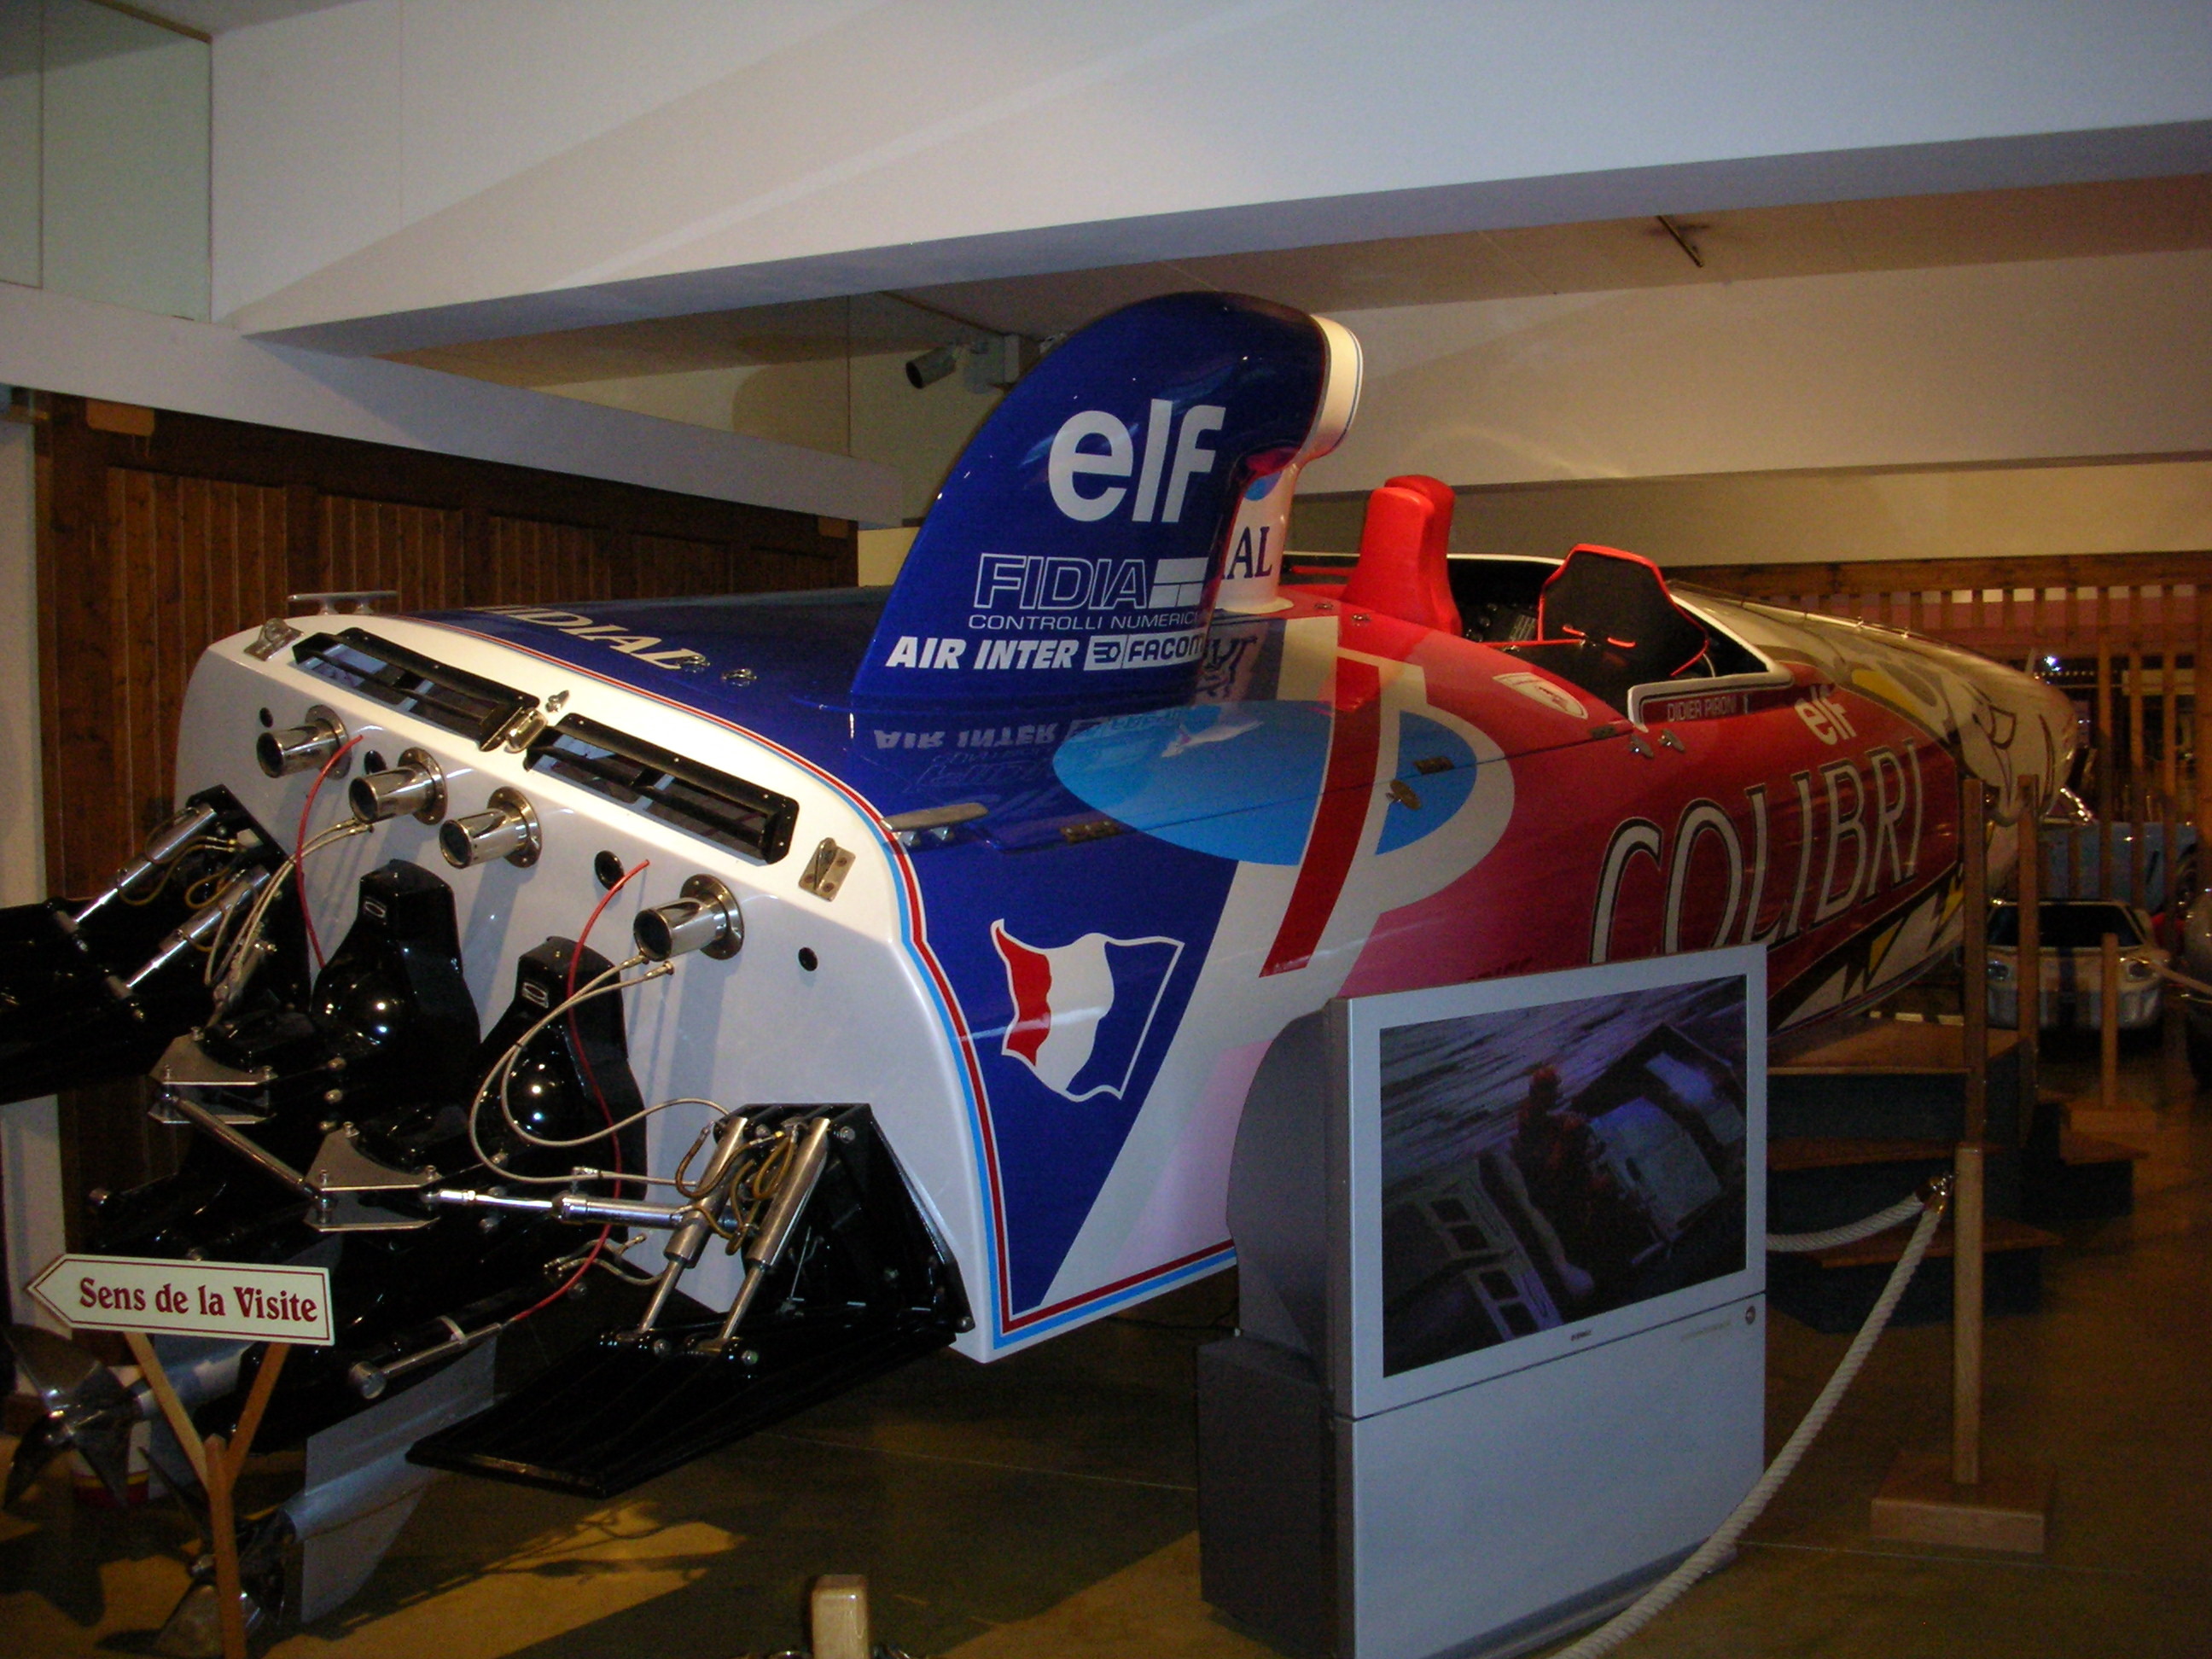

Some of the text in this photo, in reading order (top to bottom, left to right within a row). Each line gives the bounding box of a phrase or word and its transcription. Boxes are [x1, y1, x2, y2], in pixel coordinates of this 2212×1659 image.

[1048, 398, 1226, 523] elf
[1223, 526, 1272, 579] AL
[973, 552, 1147, 610] FIDIA
[969, 614, 1103, 631] CONTROLLI
[885, 635, 1080, 670] AIR INTER
[1128, 633, 1204, 662] FACOM
[1667, 701, 1703, 722] DIDIER
[1794, 684, 1858, 745] elf
[1591, 737, 1923, 963] COLIBRI
[79, 1277, 317, 1322] Sens de la Visite
